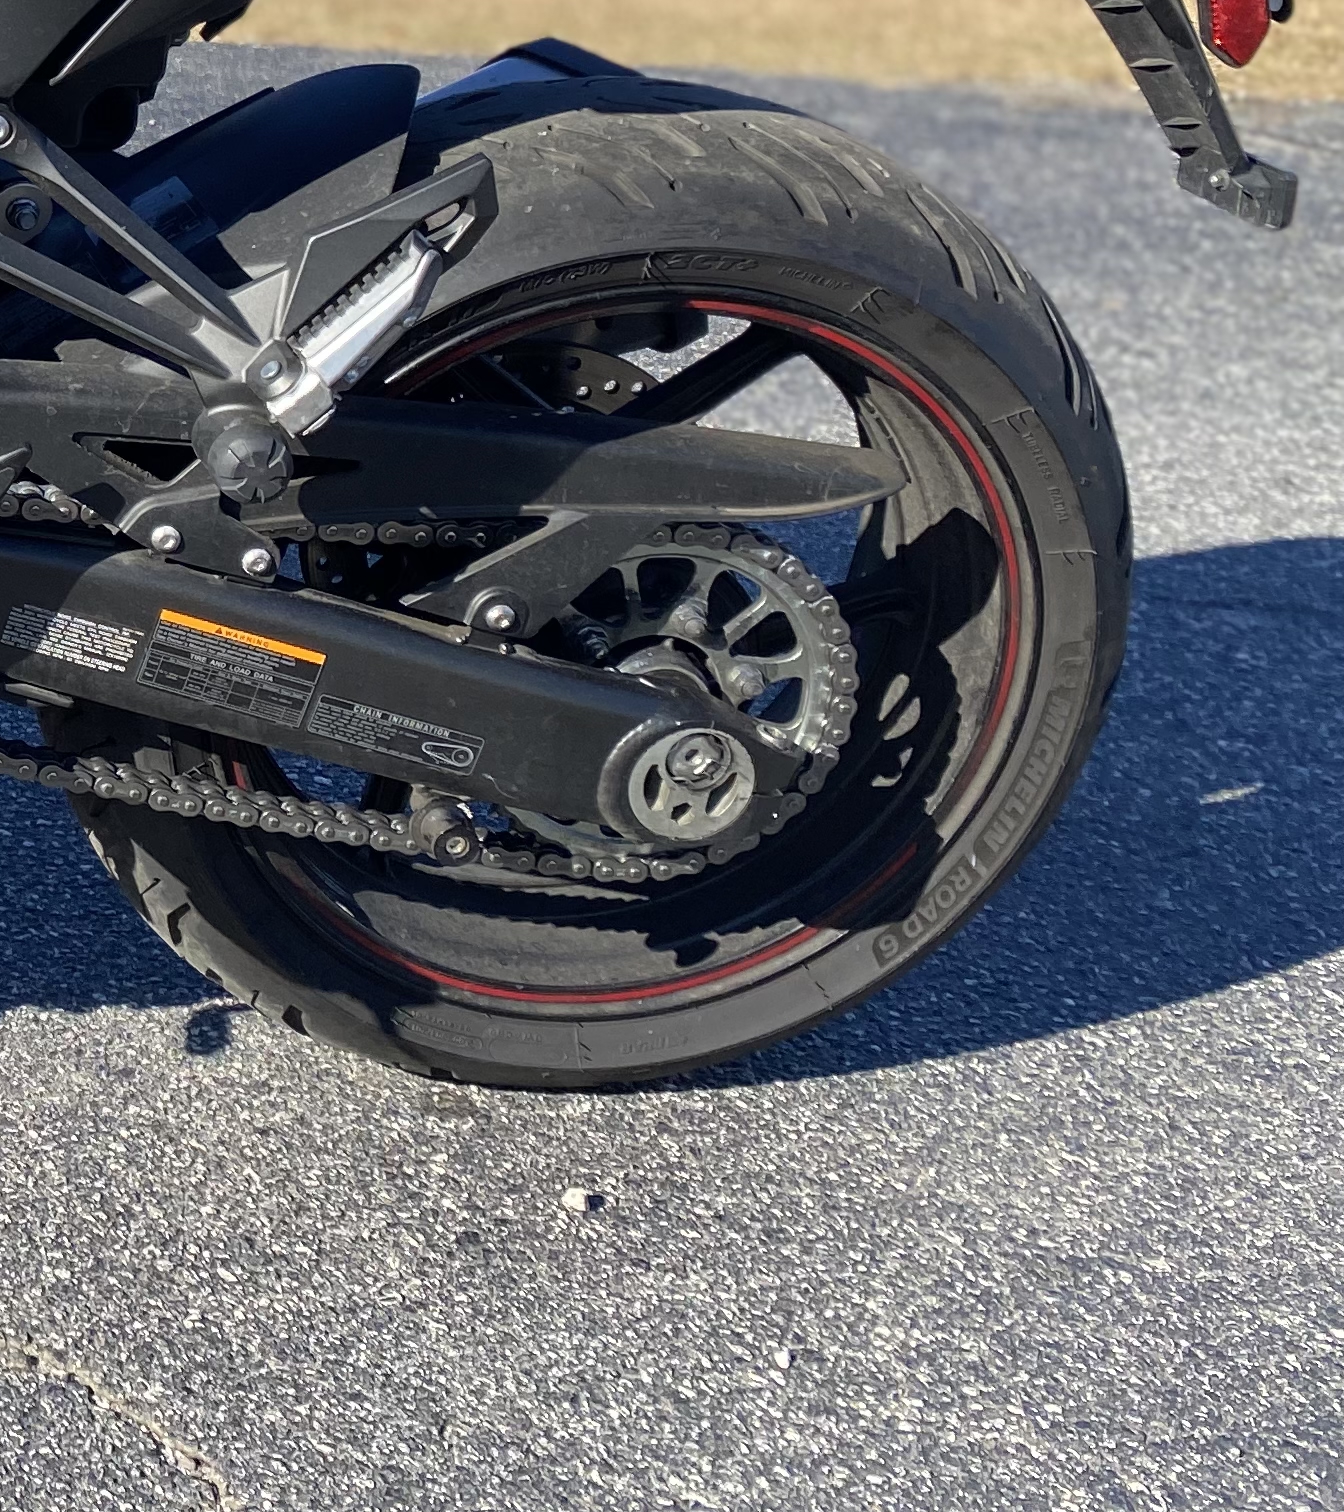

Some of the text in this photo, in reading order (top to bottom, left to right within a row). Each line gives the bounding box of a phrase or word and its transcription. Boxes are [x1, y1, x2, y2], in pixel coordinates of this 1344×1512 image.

[225, 631, 270, 648] WARNING
[189, 653, 274, 682] TIRE AND LOAD DATA
[353, 705, 450, 737] CHAIN INFORMATION
[879, 696, 1072, 956] MICHELIN ROAD 6
